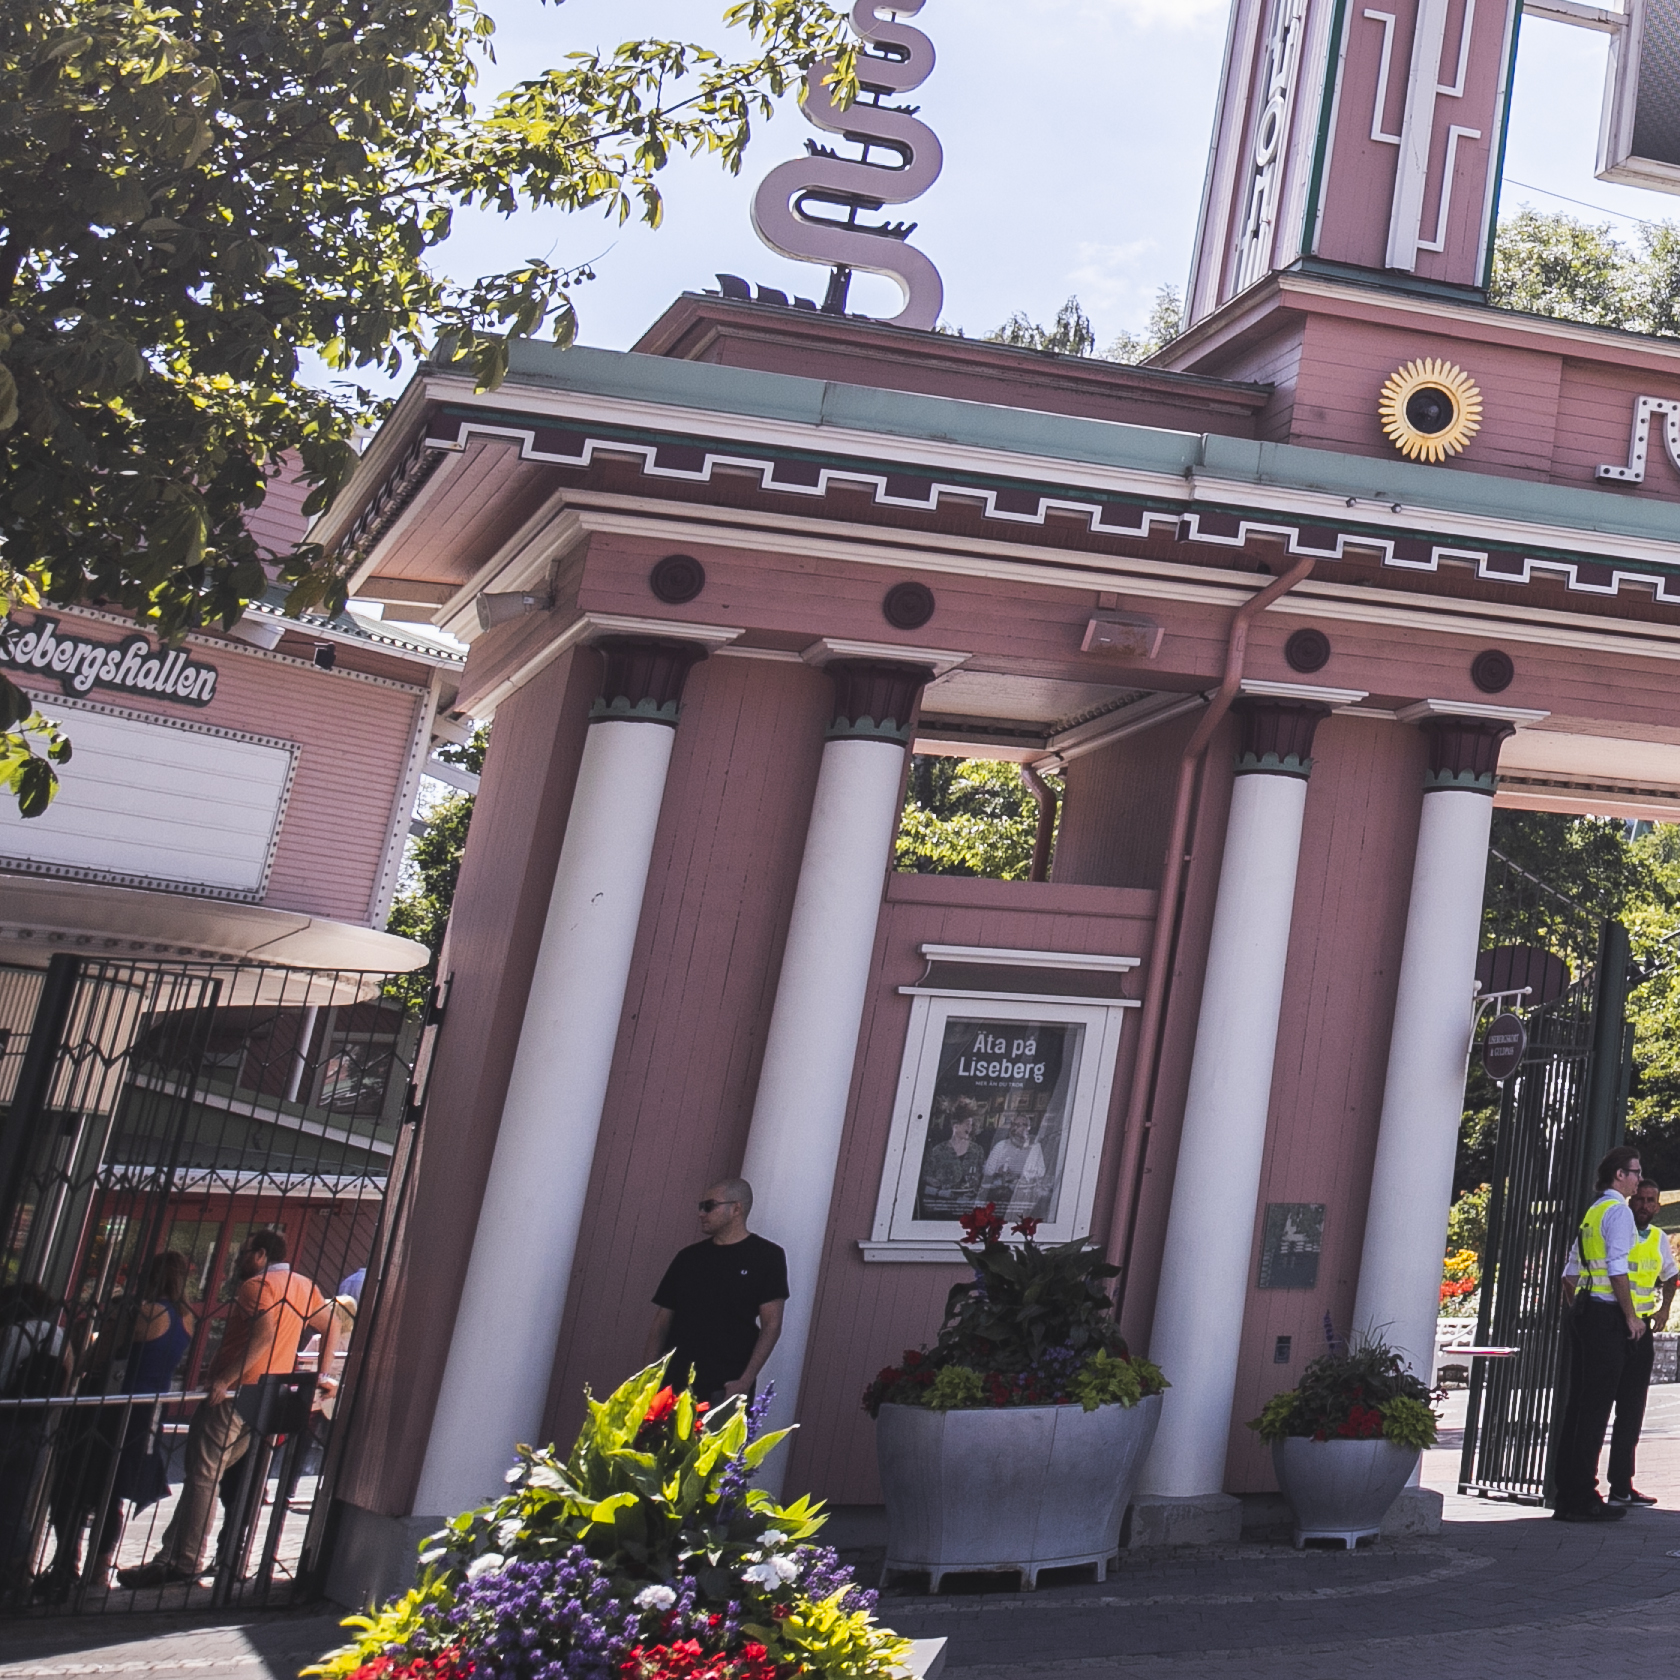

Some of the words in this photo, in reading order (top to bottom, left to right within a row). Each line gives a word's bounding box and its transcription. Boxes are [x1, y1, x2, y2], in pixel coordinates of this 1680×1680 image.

[973, 1031, 1006, 1053] Äta
[1012, 1036, 1037, 1058] på
[958, 1056, 1046, 1083] Liseberg
